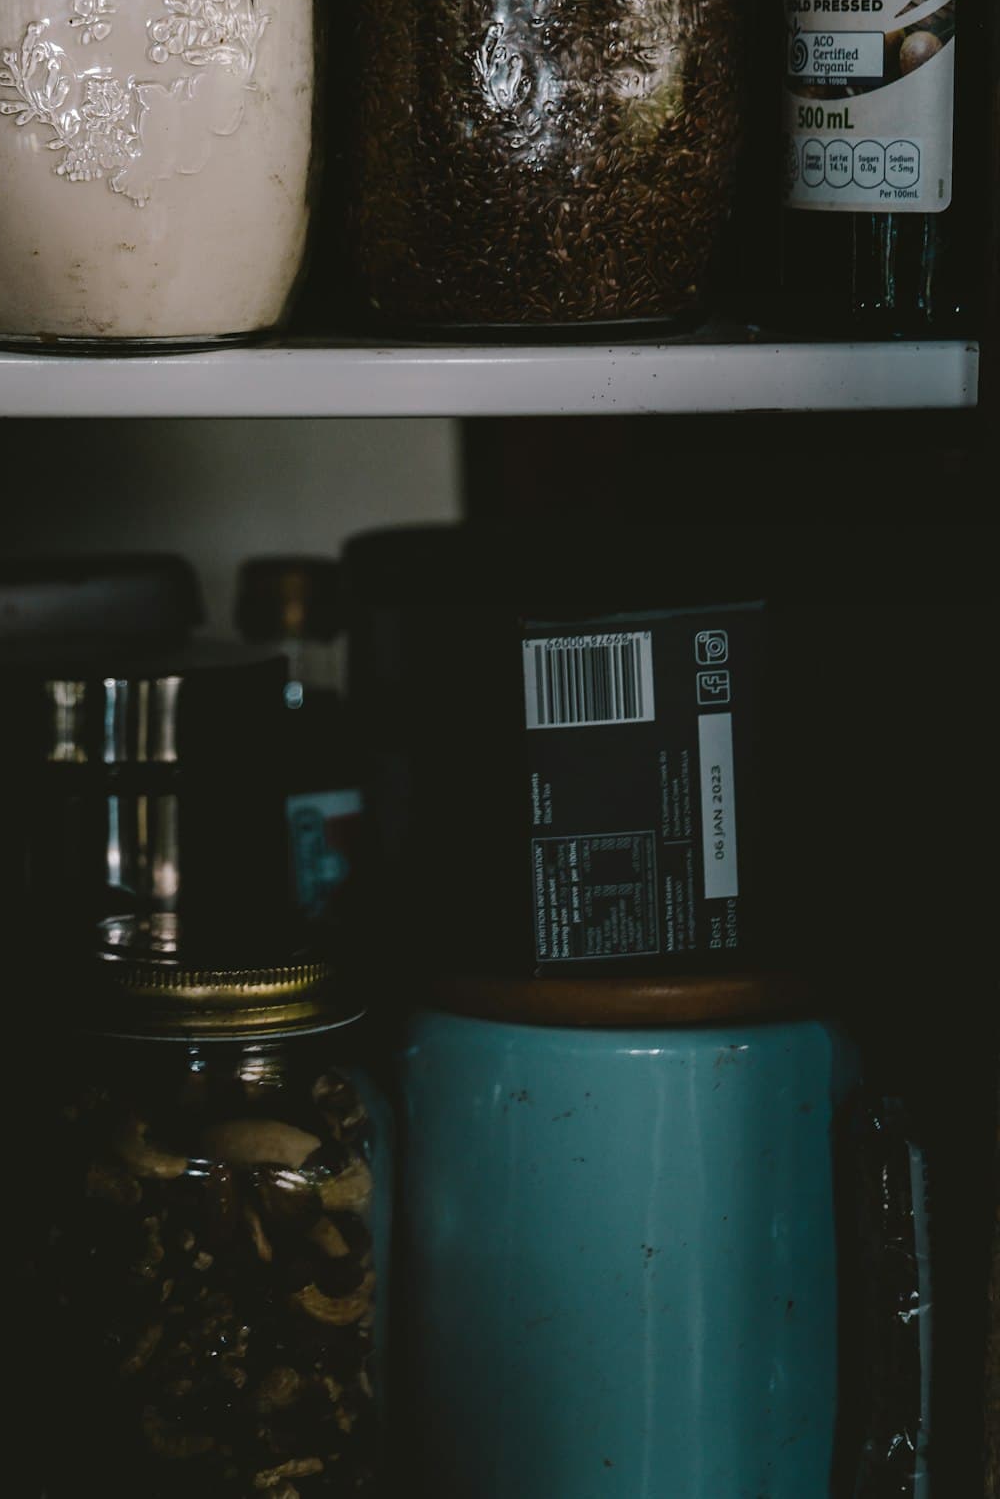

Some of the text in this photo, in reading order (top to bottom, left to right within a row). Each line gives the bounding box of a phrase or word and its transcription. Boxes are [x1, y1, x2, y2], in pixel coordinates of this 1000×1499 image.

[813, 0, 883, 12] PRESSED
[812, 35, 834, 47] ACO
[812, 49, 859, 61] Certified
[812, 61, 855, 75] Organic
[797, 106, 854, 130] 500 mL
[858, 154, 880, 164] Sugars
[889, 154, 915, 164] Sodium
[860, 163, 877, 174] 0.0g
[879, 189, 920, 199] Per 100mL
[711, 765, 726, 860] 06 JAN 2023
[535, 846, 547, 956] NUTRITION INFORMATION
[725, 898, 738, 949] Before
[709, 916, 722, 949] Best
[550, 922, 560, 958] Servings
[561, 926, 571, 958] Serving
